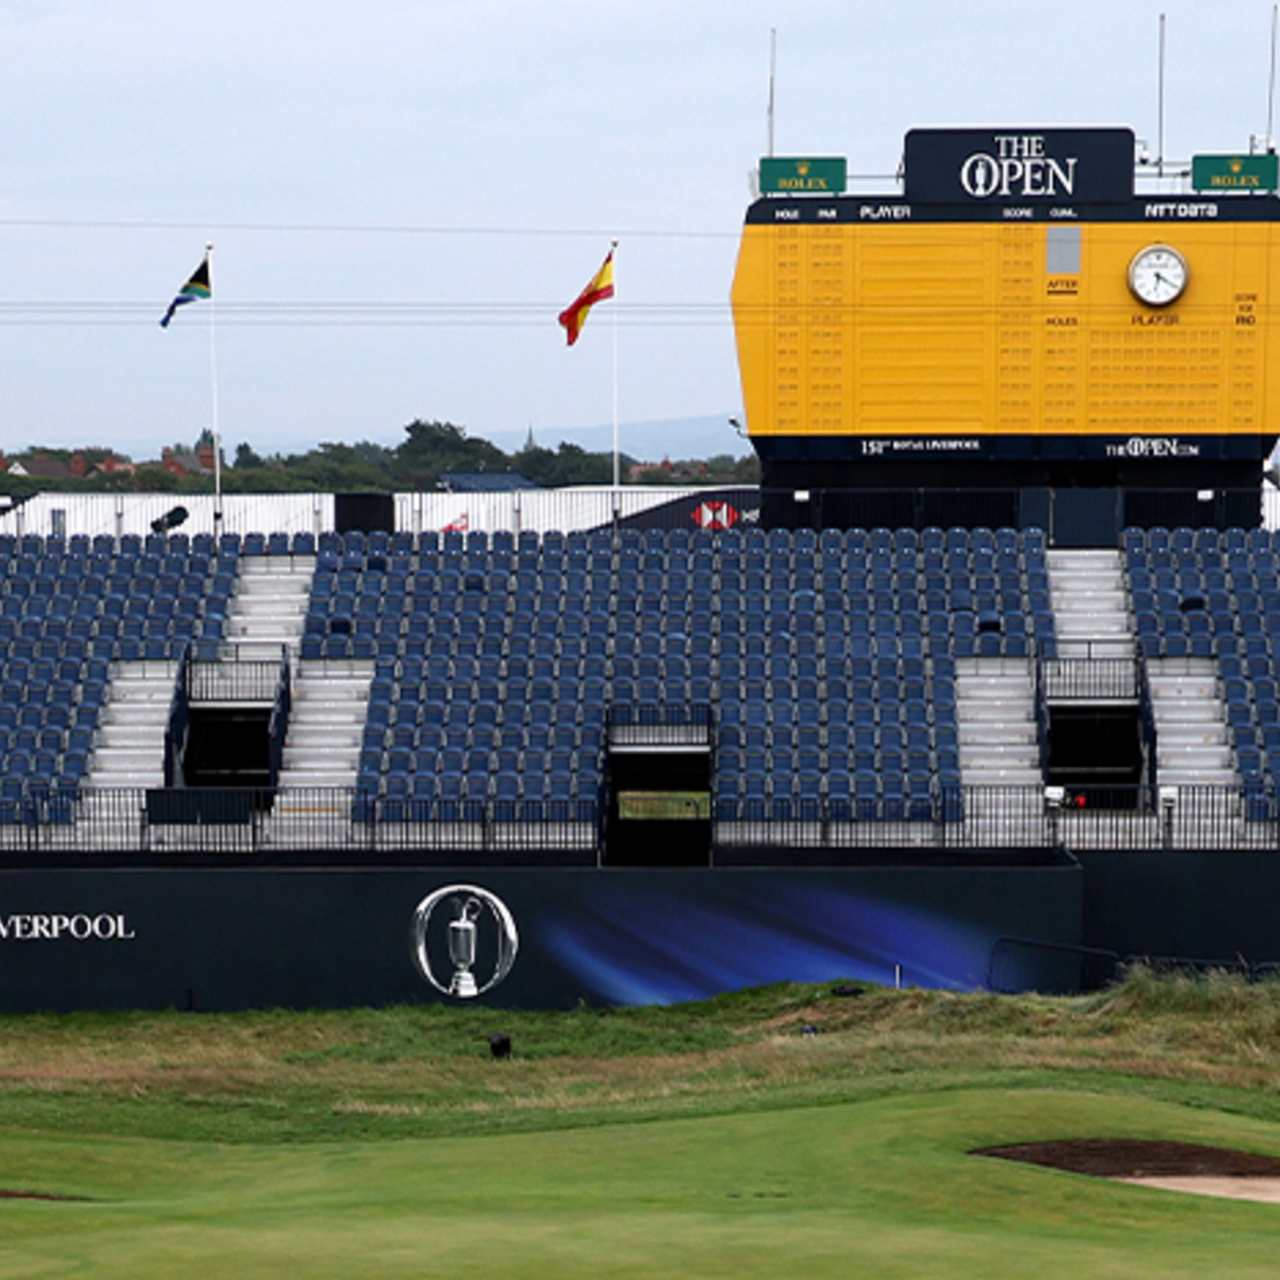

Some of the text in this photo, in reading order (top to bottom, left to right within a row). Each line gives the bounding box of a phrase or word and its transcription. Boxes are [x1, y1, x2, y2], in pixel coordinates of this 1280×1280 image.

[994, 136, 1045, 158] THE
[961, 153, 1077, 197] OPEN
[777, 178, 829, 189] ROLEX
[860, 204, 911, 218] PLAYER
[1048, 280, 1078, 289] AFTER
